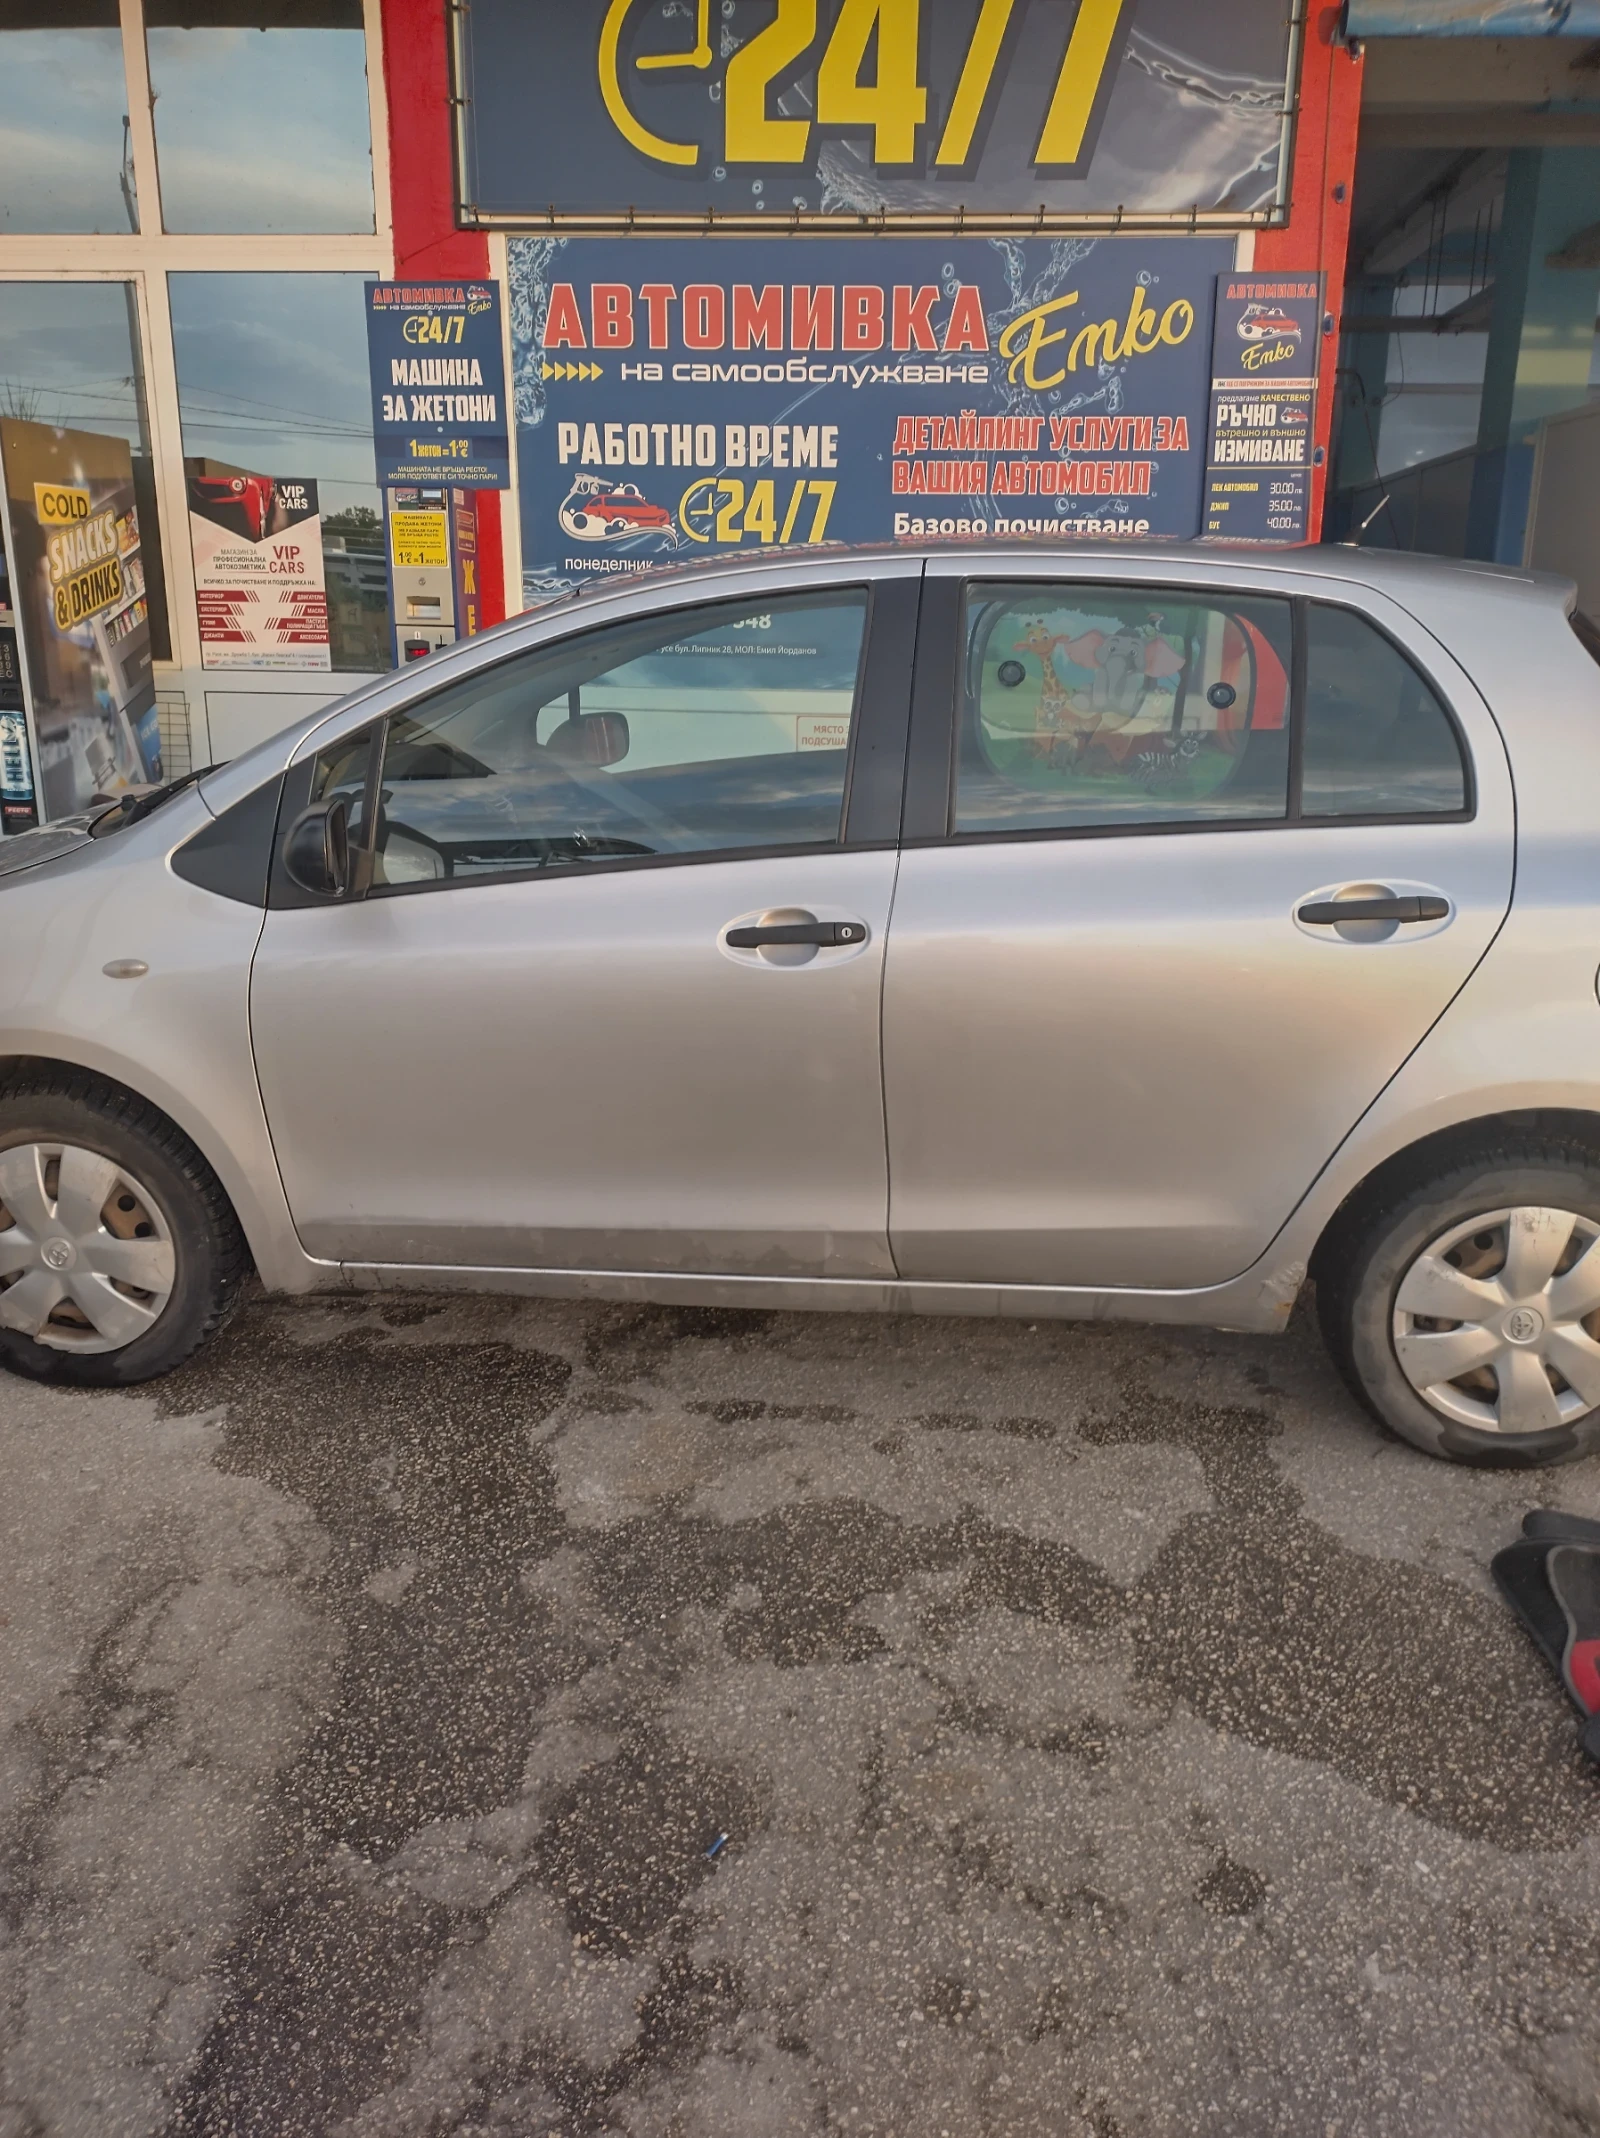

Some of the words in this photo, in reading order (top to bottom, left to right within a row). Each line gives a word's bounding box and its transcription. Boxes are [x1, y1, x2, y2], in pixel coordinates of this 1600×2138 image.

[725, 0, 1123, 165] 24/7
[372, 288, 466, 304] АВТОМИВКА
[1226, 283, 1318, 299] АВТОМИВКА
[400, 303, 466, 311] самообслужване
[542, 283, 990, 352] АВТОМИВКА
[417, 316, 466, 344] 24/7
[391, 358, 484, 386] МАШИНА
[621, 362, 663, 382] на
[672, 356, 989, 389] самообслужване
[382, 394, 408, 422] ЗА
[410, 394, 496, 422] ЖЕТОНИ
[1217, 394, 1260, 403] предлагаме
[1260, 393, 1311, 402] КАЧЕСТВЕНО
[1216, 404, 1277, 427] РЪЧНО
[892, 409, 1046, 456] ДЕТАЙЛИНГ
[1049, 416, 1153, 452] УСЛУГИ
[1153, 416, 1190, 451] ЗА
[1215, 429, 1261, 438] вътрешно
[1262, 429, 1268, 437] и
[1270, 429, 1306, 437] външно
[558, 422, 716, 466] РАБОТНО
[725, 425, 839, 468] ВРЕМЕ
[1213, 439, 1306, 463] ИЗМИВАНЕ
[892, 461, 990, 496] ВАШИЯ
[991, 461, 1152, 496] АВТОМОБИЛ
[1270, 483, 1294, 494] 30.00
[281, 485, 305, 498] VIP
[42, 492, 88, 519] COLD
[279, 498, 308, 509] CARS
[715, 479, 838, 545] 24/7
[1268, 500, 1293, 512] 35.00
[894, 512, 988, 535] Базово
[995, 518, 1150, 535] почистване
[1267, 517, 1292, 529] 40.00
[50, 513, 117, 580] SNACKS
[272, 545, 300, 560] VIP
[269, 561, 305, 574] CARS
[565, 557, 653, 573] понеделник
[57, 590, 69, 626] &
[70, 560, 121, 618] DRINKS
[674, 644, 690, 654] бул.
[691, 645, 721, 653] Липник
[735, 646, 756, 654] МОЛ:
[756, 646, 776, 654] Емил
[777, 645, 817, 656] Йорданов
[813, 725, 845, 734] МЯСТО
